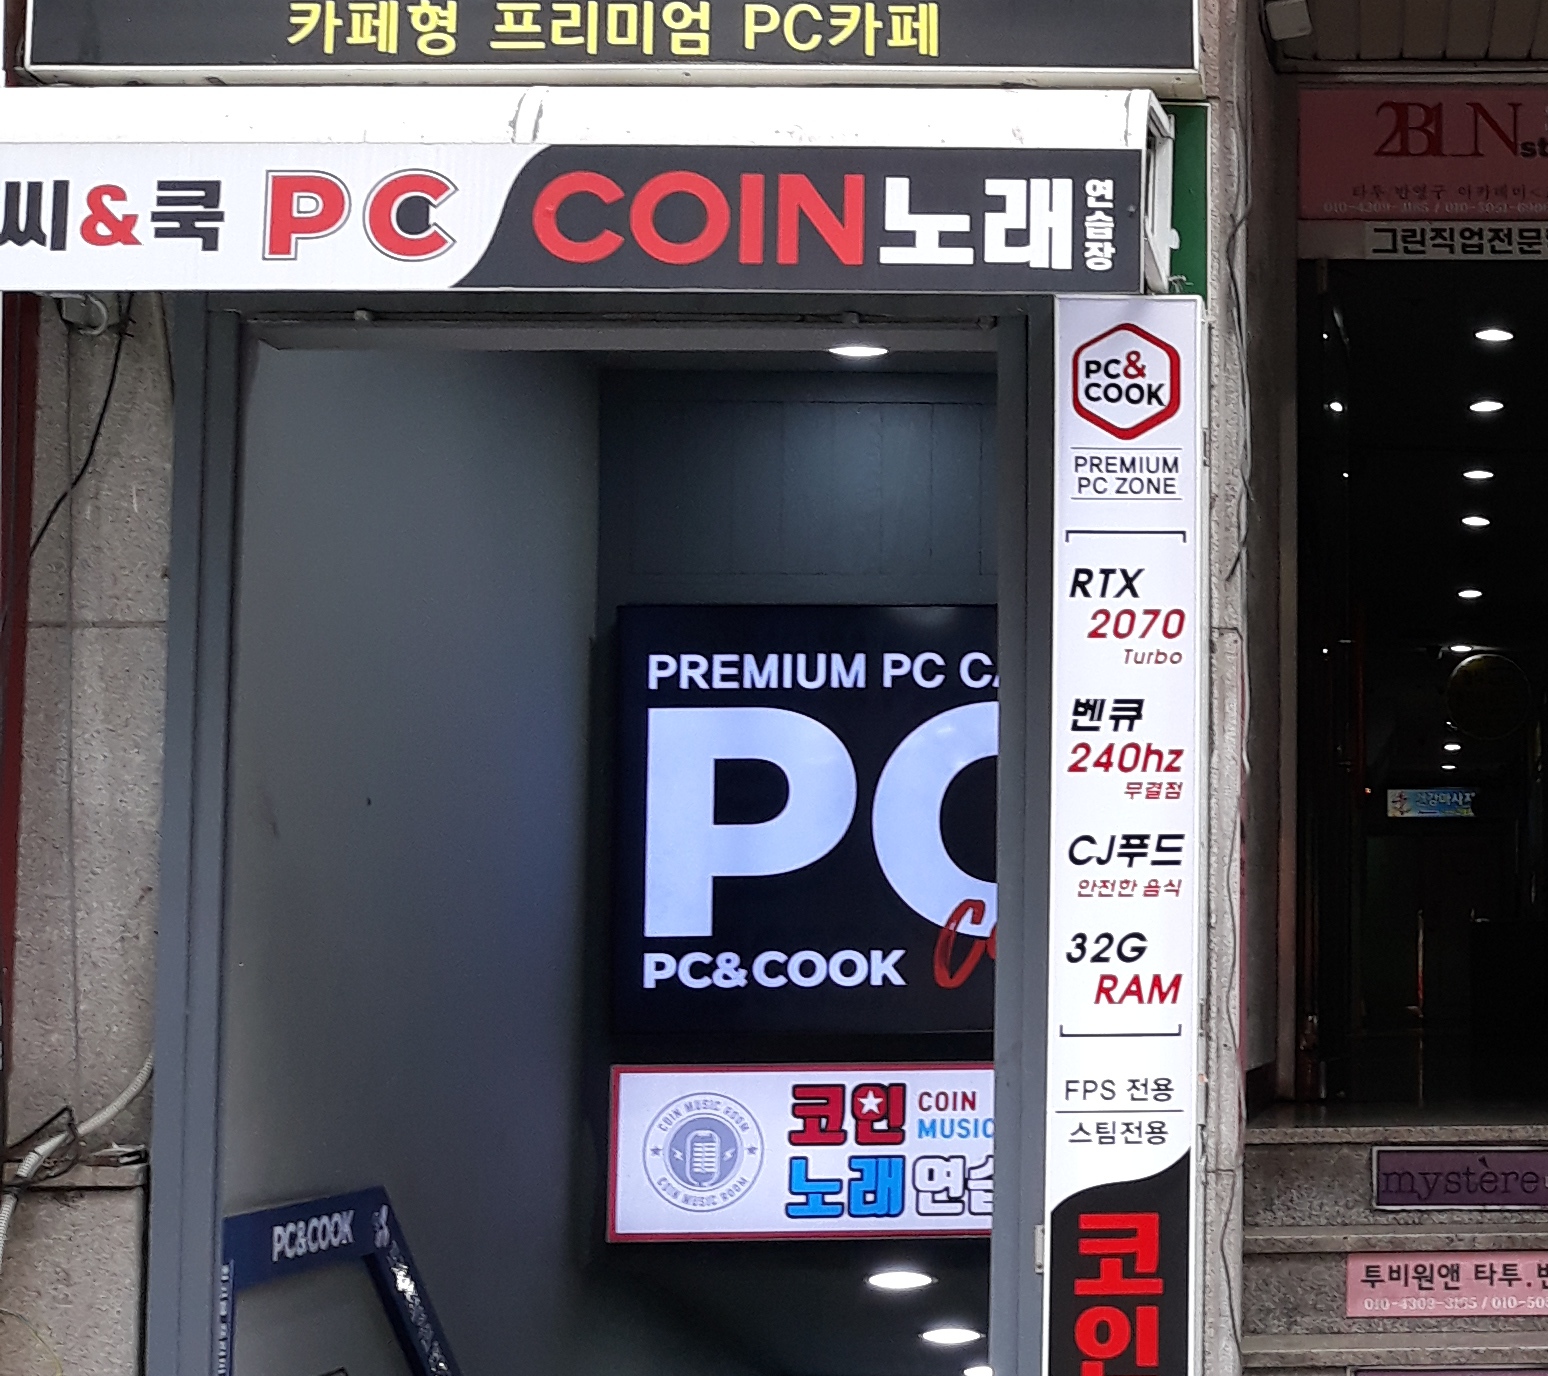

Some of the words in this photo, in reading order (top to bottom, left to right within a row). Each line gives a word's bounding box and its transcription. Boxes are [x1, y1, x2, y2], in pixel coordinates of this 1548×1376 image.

[289, 0, 460, 57] 카페형
[489, 0, 713, 56] 프리미엄
[744, 0, 942, 58] PC카페
[262, 168, 460, 263] PC
[1085, 178, 1113, 273] 연습장
[1085, 350, 1146, 380] PC&
[1085, 382, 1167, 407] COOK
[1074, 456, 1180, 474] PREMIUM
[1078, 477, 1108, 495] PC
[1115, 477, 1177, 495] ZONE
[1069, 568, 1145, 598] RTX
[1087, 609, 1186, 639] 2070
[647, 653, 867, 690] PREMIUM
[883, 652, 946, 688] PC
[959, 652, 1000, 688] C
[1123, 649, 1183, 665] Turbo
[1071, 698, 1145, 733] 벤큐
[1067, 742, 1184, 774] 240hz
[1124, 781, 1183, 801] 무결점
[1068, 833, 1185, 869] CJ푸드
[1077, 878, 1138, 899] 안전한
[1142, 878, 1182, 898] 음식
[1065, 932, 1148, 964] 32G
[642, 950, 908, 990] PC&COOK
[1094, 973, 1183, 1005] RAM
[918, 1091, 976, 1112] COIN
[1065, 1080, 1116, 1101] FPS
[1126, 1077, 1175, 1103] 전용
[788, 1083, 906, 1146] 코인
[1068, 1121, 1169, 1146] 스팀전용
[1360, 1263, 1460, 1290] 투비원앤
